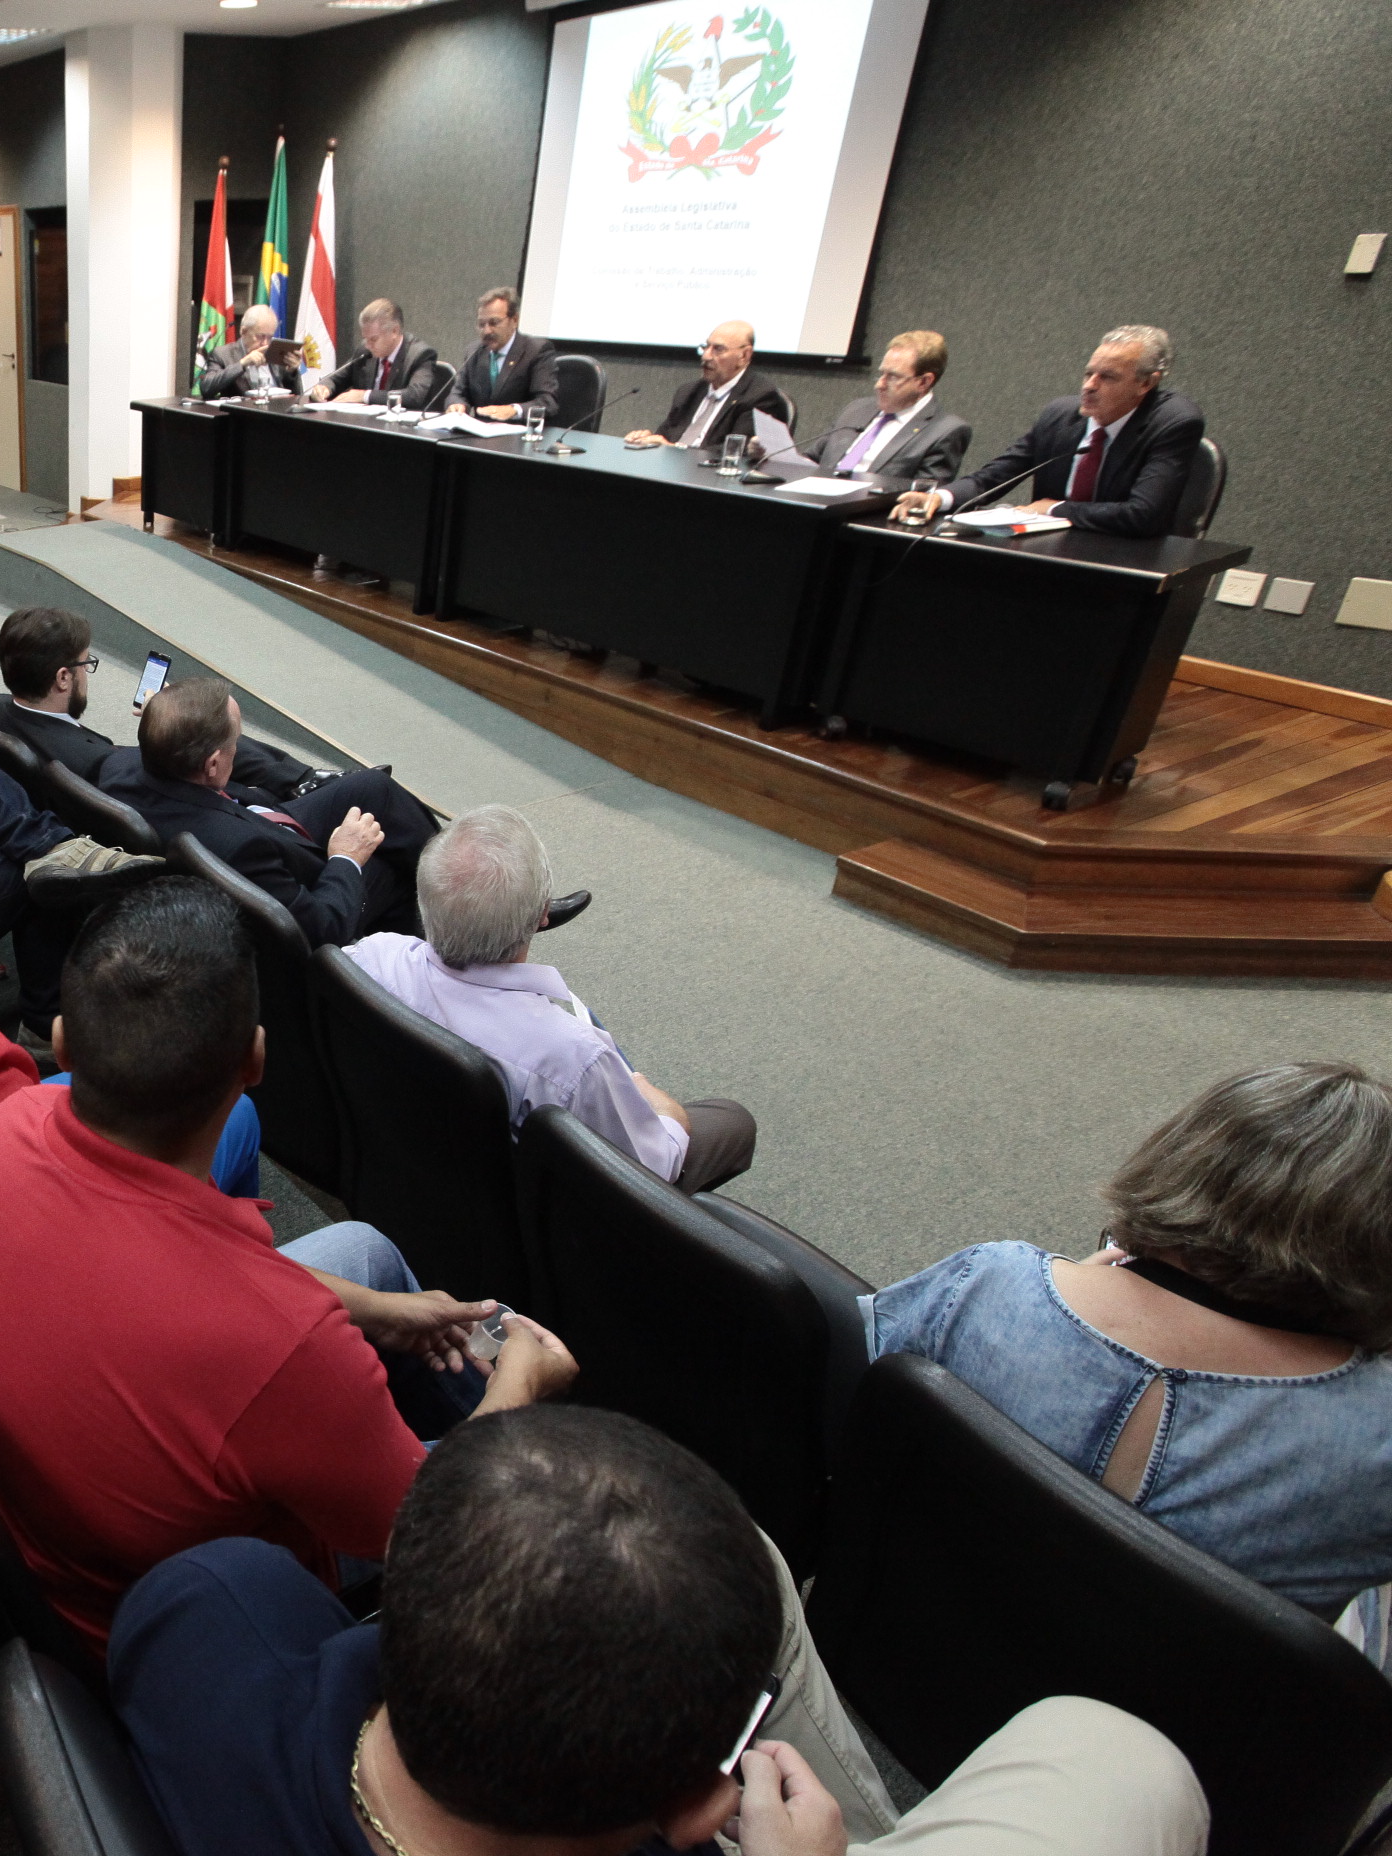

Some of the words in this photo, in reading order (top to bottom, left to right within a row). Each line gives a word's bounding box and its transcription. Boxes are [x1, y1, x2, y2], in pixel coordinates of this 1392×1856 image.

[622, 204, 678, 214] Assembleia
[681, 200, 738, 214] Legislativa
[622, 222, 656, 232] Estado
[659, 222, 670, 231] de
[674, 221, 703, 231] Santa
[706, 219, 751, 231] Catarina
